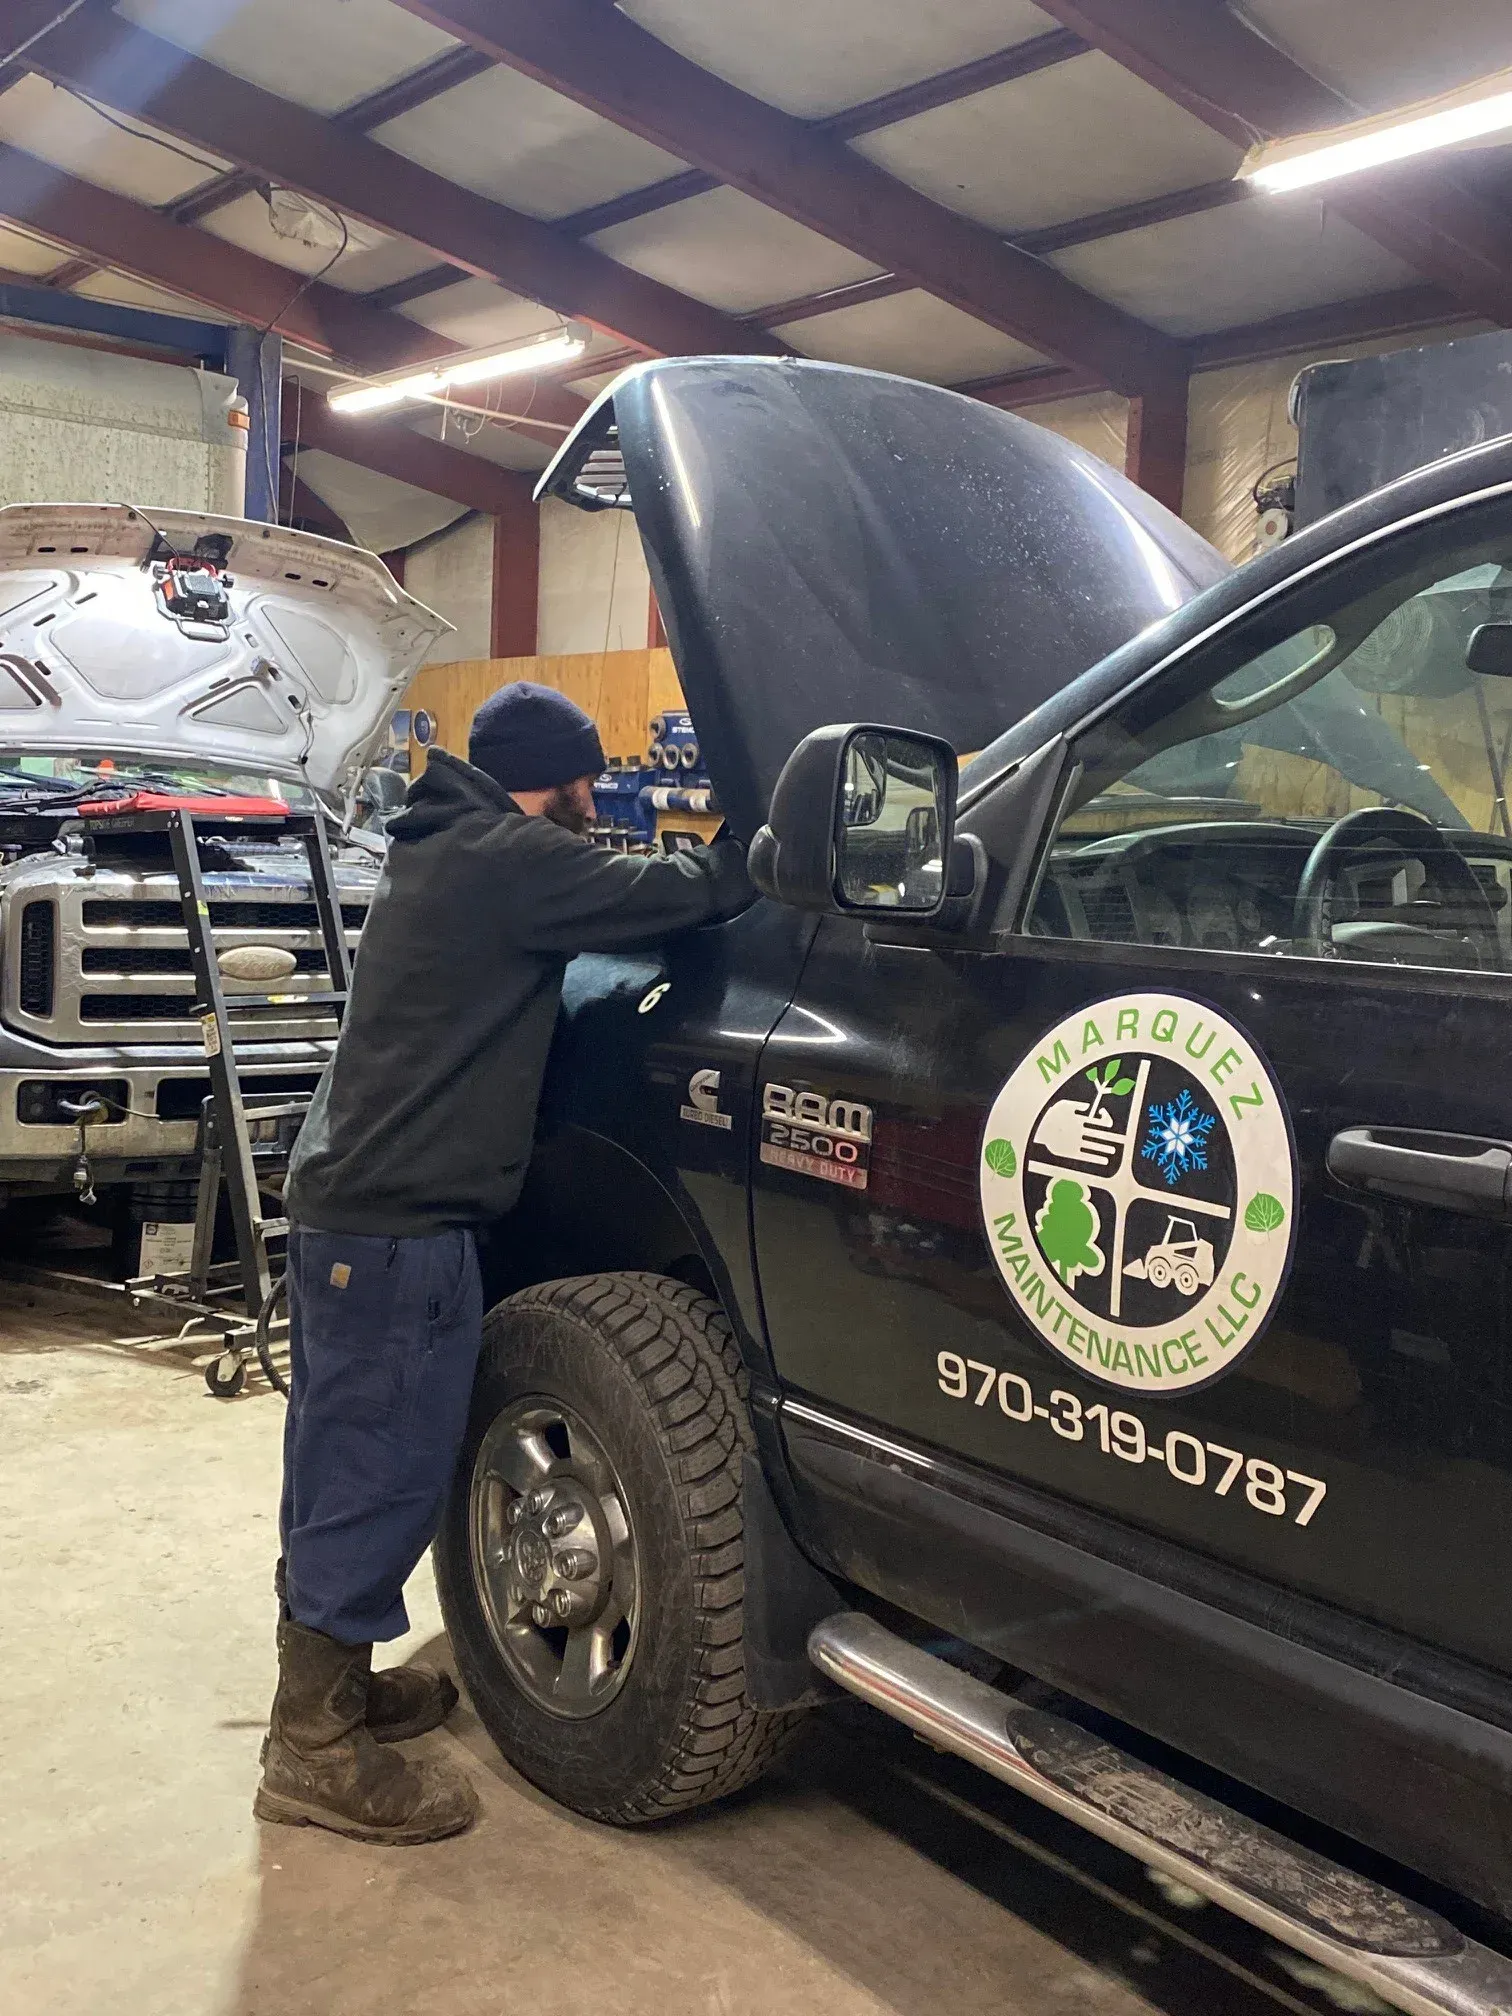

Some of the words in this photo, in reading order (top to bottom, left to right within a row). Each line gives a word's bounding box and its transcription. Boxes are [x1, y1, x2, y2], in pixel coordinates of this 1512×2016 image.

[1036, 1008, 1264, 1120] MARQUEZ
[763, 1083, 873, 1136] RAM
[770, 1123, 858, 1163] 2500
[770, 1147, 815, 1172] HEAVY
[820, 1160, 856, 1183] DUTY
[993, 1212, 1209, 1378] MAINTENANCE
[1204, 1271, 1262, 1349] LLC
[937, 1350, 1327, 1527] 970-319-0787
